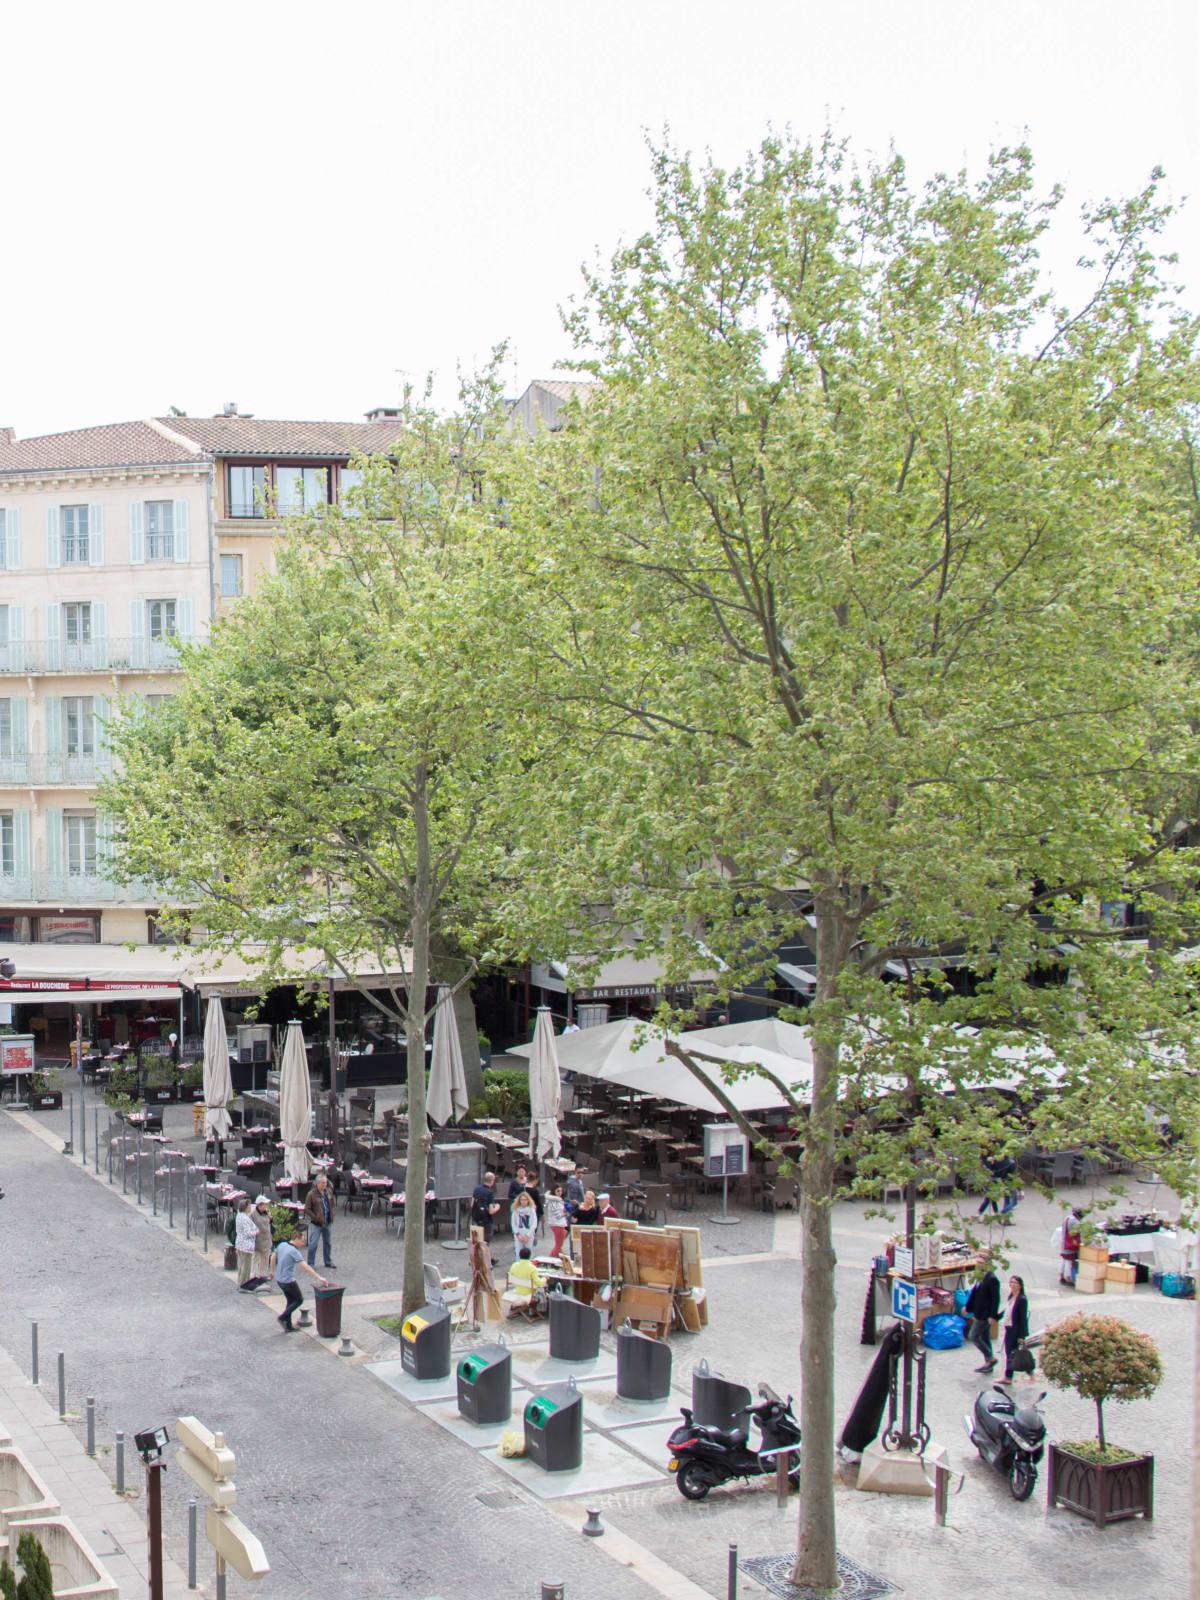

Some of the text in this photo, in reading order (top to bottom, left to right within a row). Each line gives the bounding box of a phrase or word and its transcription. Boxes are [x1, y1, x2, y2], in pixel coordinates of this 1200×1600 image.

[31, 981, 39, 989] LA
[39, 982, 70, 990] BOUCHERIE
[593, 989, 609, 998] BAR
[518, 1214, 531, 1230] N
[898, 1287, 909, 1311] P
